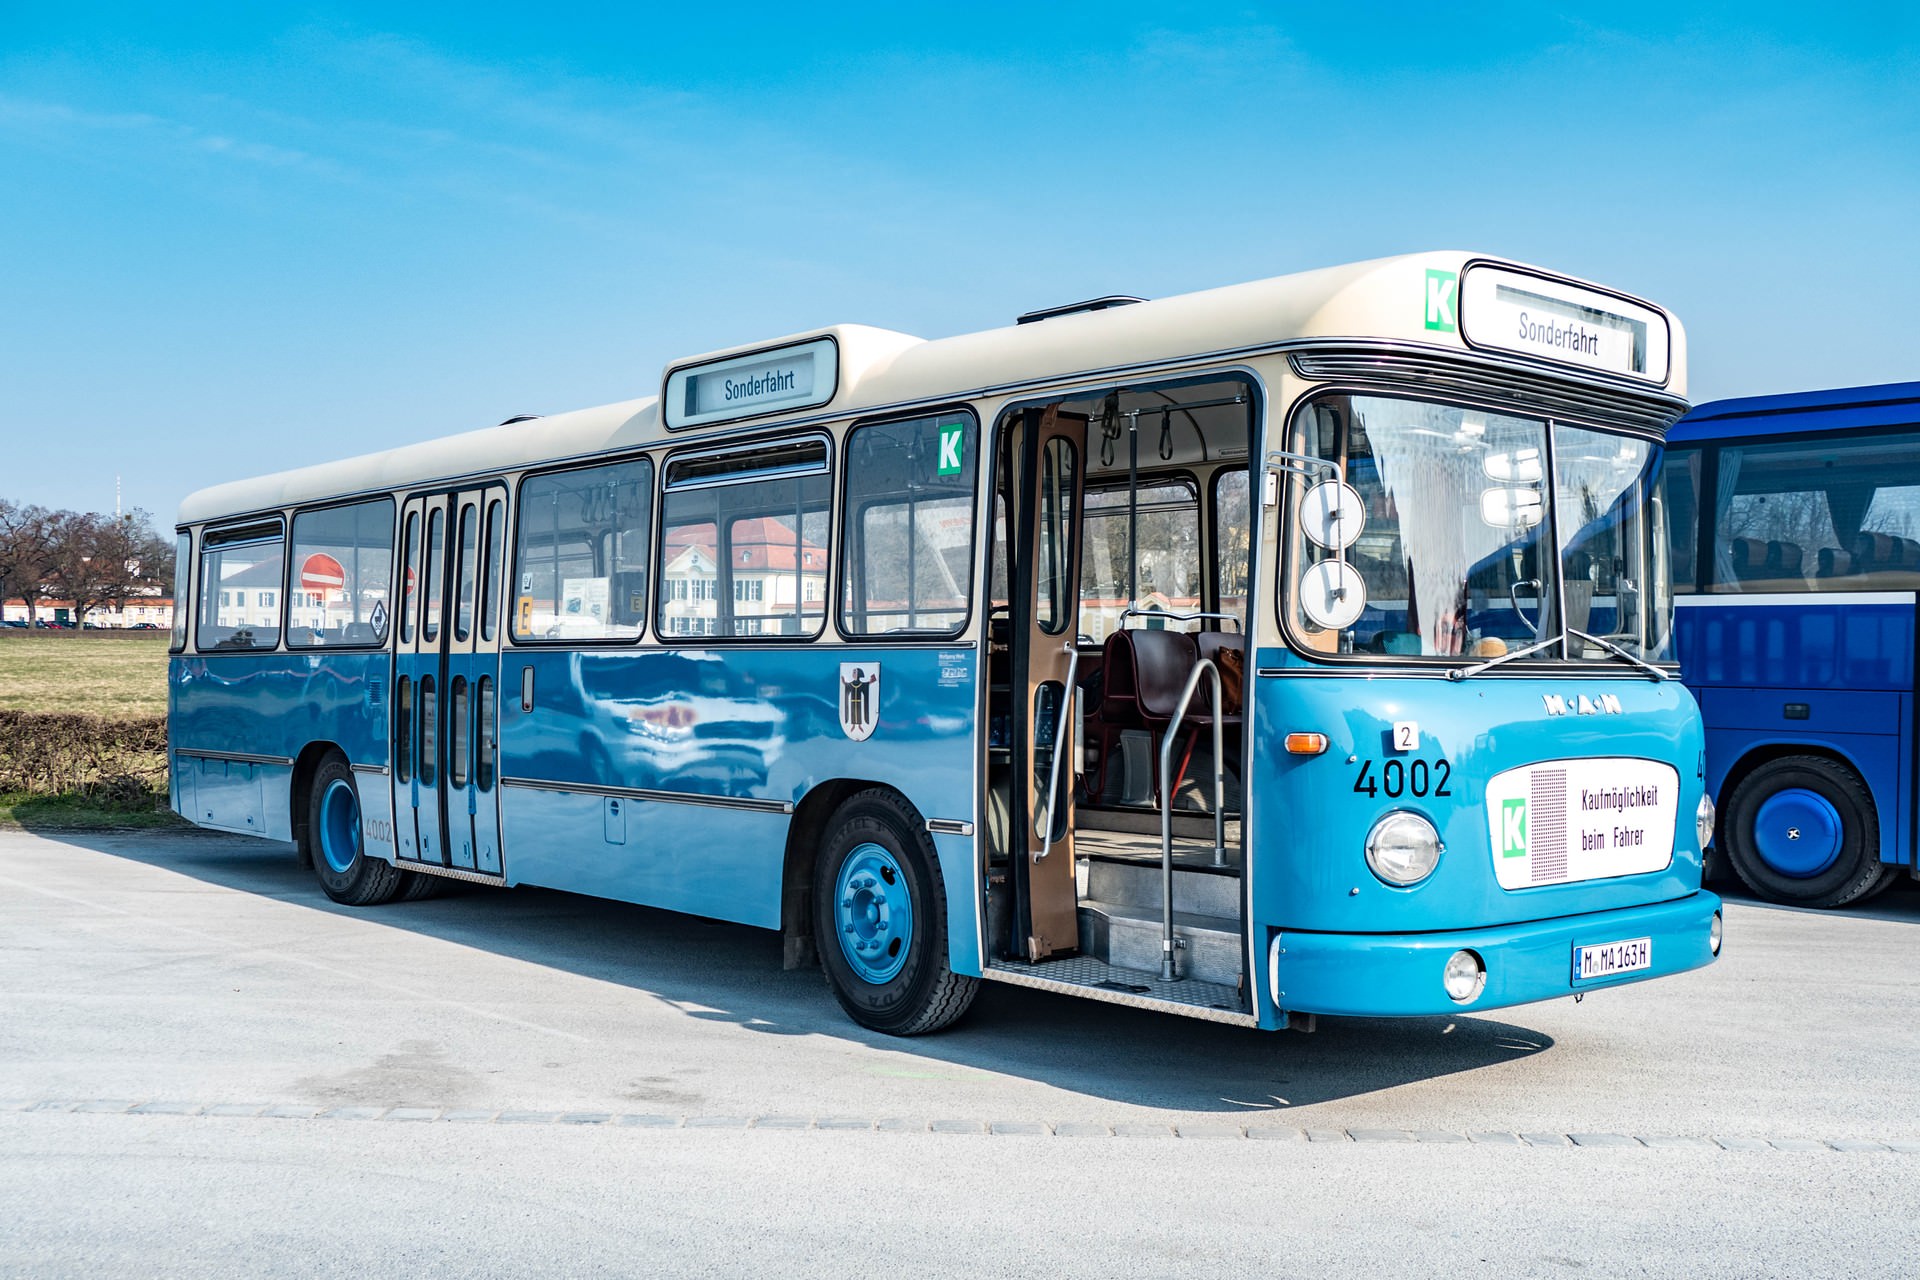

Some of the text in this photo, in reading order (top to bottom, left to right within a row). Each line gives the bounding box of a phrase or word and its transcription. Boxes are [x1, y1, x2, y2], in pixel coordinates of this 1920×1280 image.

[1427, 277, 1455, 325] K
[1518, 311, 1598, 356] Sonderfahrt
[725, 370, 794, 400] Sonderfahrt
[940, 430, 962, 469] K
[1401, 727, 1412, 746] 2
[1354, 759, 1451, 798] 4002
[1581, 785, 1658, 813] Kaufmöglichkeit
[366, 818, 392, 843] 4002
[1504, 806, 1526, 851] K
[1581, 827, 1644, 851] beim Fahrer
